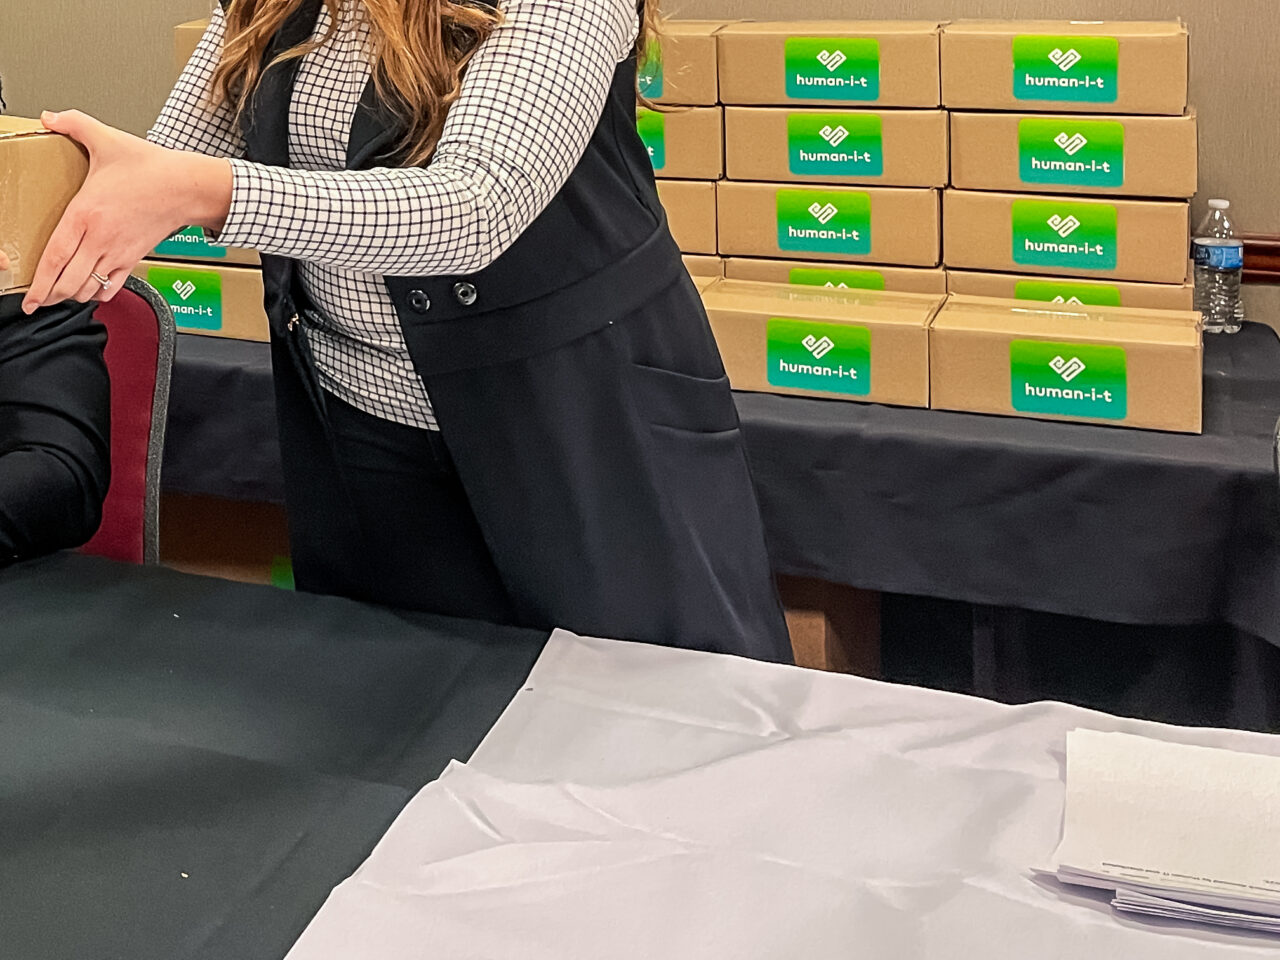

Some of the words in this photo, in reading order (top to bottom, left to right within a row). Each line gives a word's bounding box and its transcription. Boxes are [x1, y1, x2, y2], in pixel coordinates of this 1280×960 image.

[796, 74, 868, 88] human-i-t
[1025, 73, 1104, 88] human-i-t
[799, 149, 871, 163] human-i-t
[1031, 157, 1111, 173] human-i-t
[788, 226, 860, 241] human-i-t
[1024, 238, 1104, 255] human-i-t
[170, 304, 213, 316] man-i-t
[779, 359, 858, 379] human-i-t
[1025, 382, 1113, 403] human-i-t
